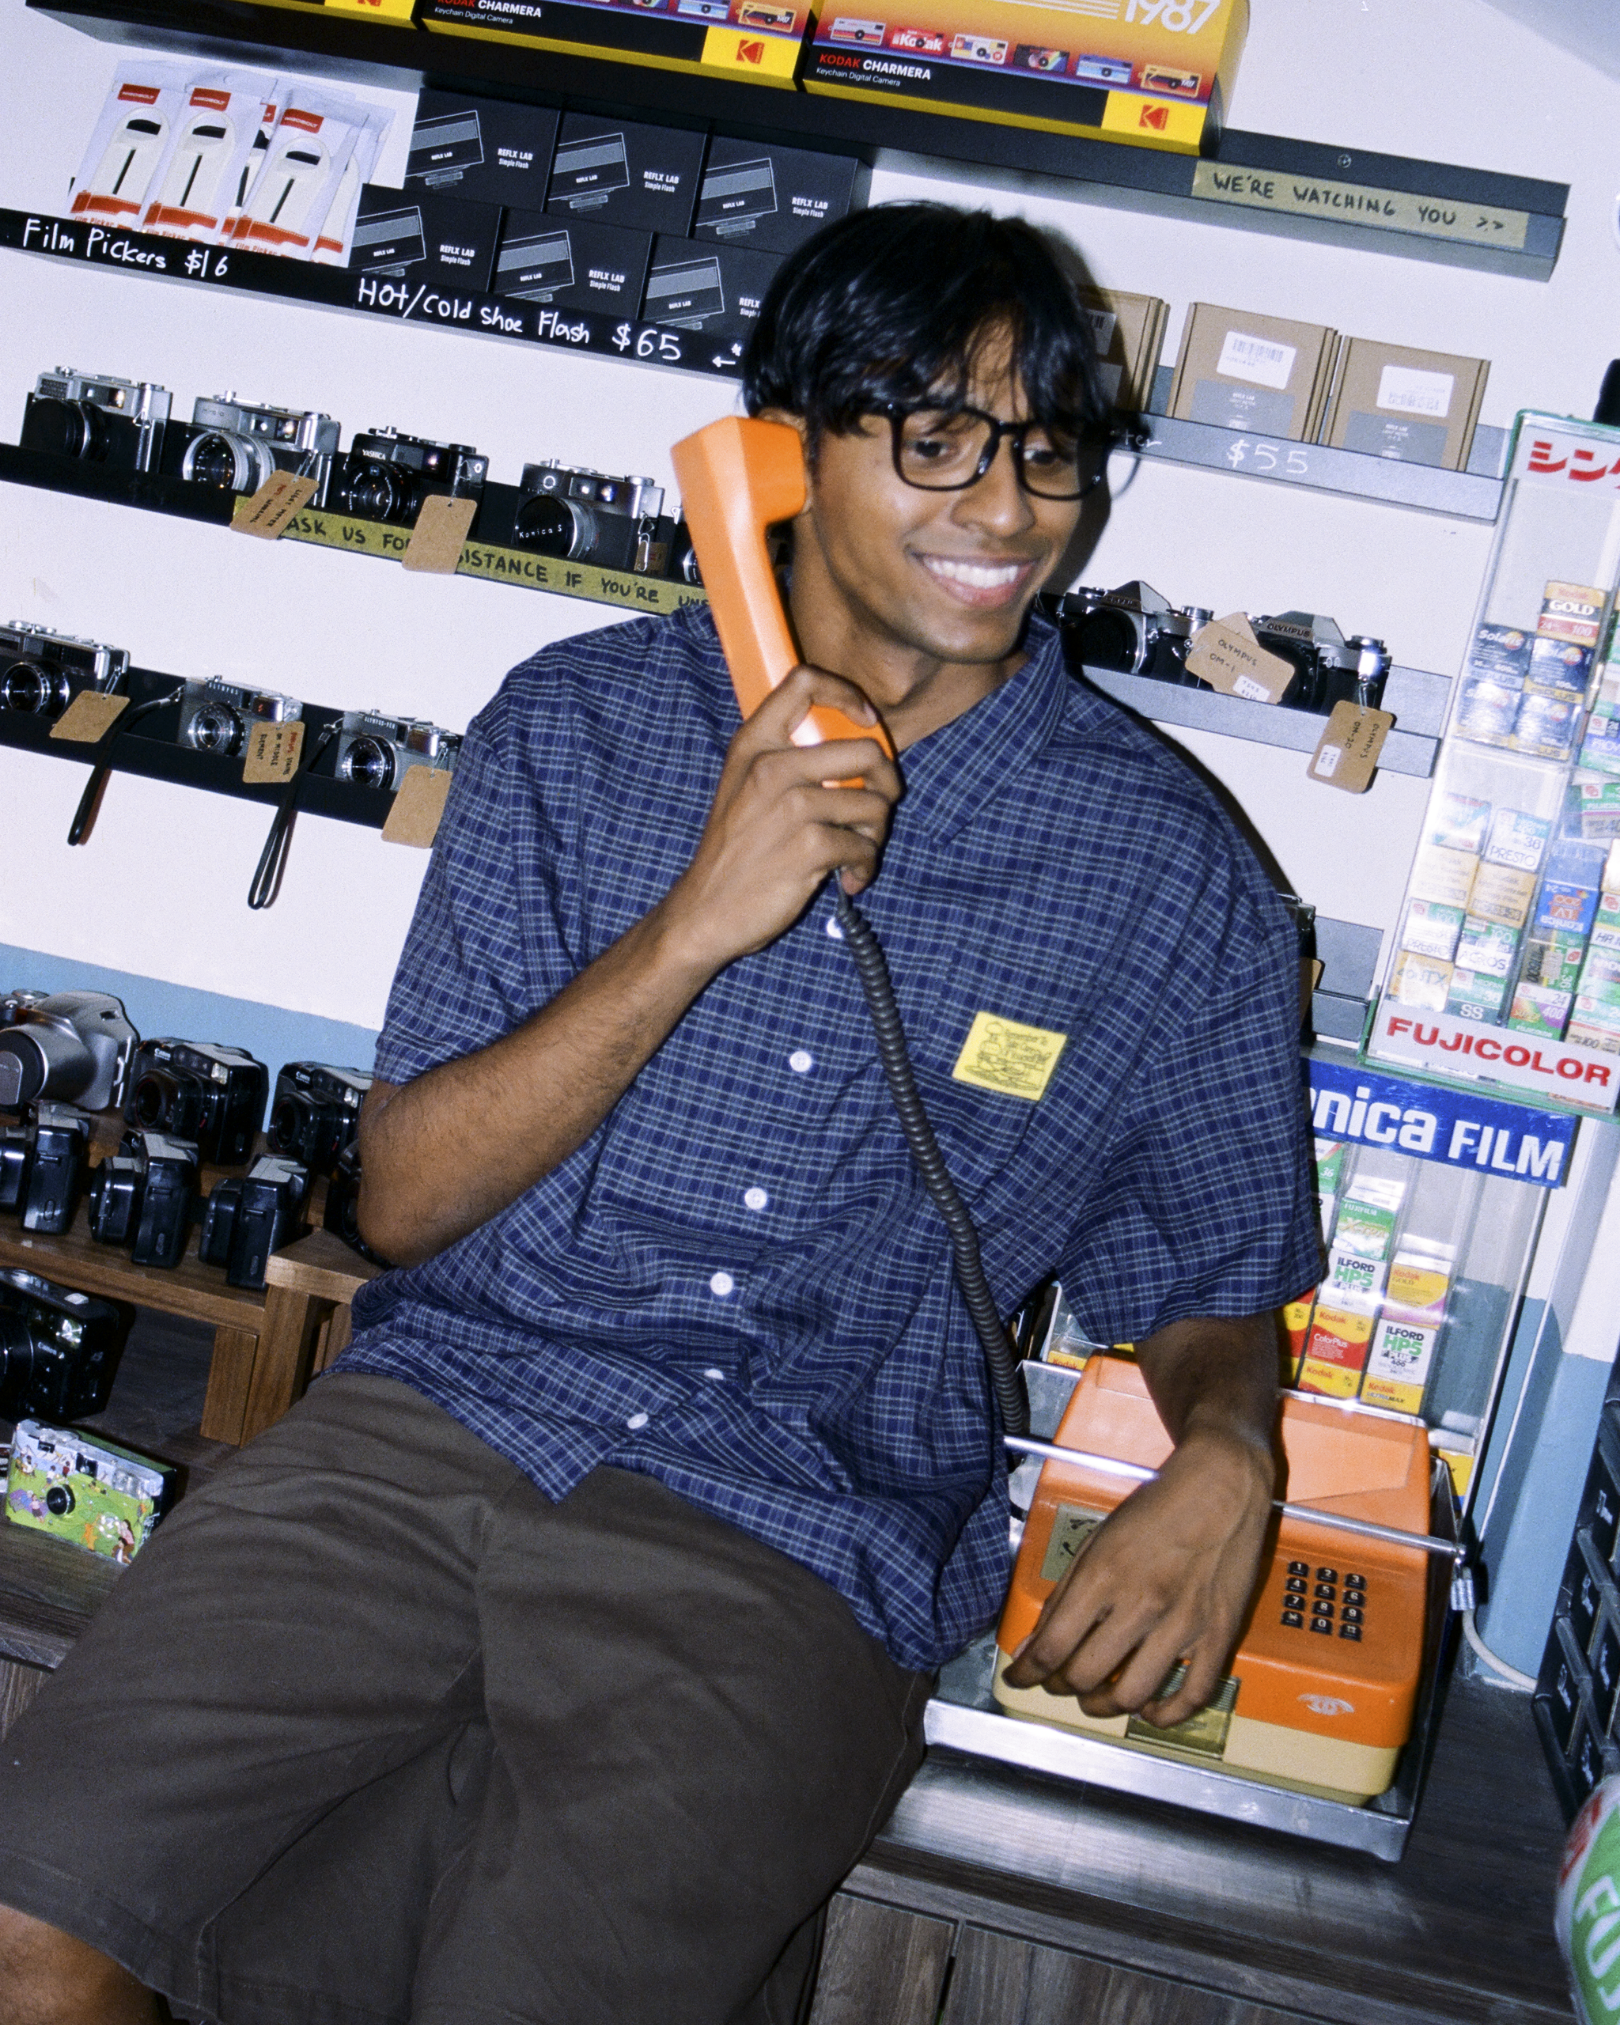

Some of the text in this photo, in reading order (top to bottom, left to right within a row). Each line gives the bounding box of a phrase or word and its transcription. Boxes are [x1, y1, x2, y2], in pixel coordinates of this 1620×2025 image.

[433, 6, 514, 25] Keychain Digital Camera
[477, 0, 542, 18] CHARMERA
[819, 53, 931, 81] KODAK CHARMERA
[816, 66, 901, 88] Keychain Digital Camera
[498, 148, 533, 161] REFLX LAB
[498, 158, 529, 169] Simple Flash
[643, 171, 680, 184] REFLX LAB
[644, 181, 675, 193] Simple Flash
[791, 197, 828, 210] REFLX LAB
[1213, 171, 1275, 199] WE'RE
[1292, 184, 1397, 217] WATCHING
[1418, 205, 1456, 226] YOU
[792, 207, 824, 218] Simple Flash
[23, 218, 229, 278] Film Pickers $16
[440, 244, 475, 258] REFLX LAB
[440, 254, 471, 266] Simple Flash
[588, 269, 625, 283] REFLX LAB
[589, 280, 621, 292] Simple Flash
[739, 297, 760, 308] REFLX
[538, 311, 590, 343] Flash
[612, 323, 682, 360] $65
[362, 449, 386, 461] YASHICA
[1226, 439, 1309, 473] $55
[557, 524, 563, 532] S
[286, 517, 326, 536] ASK
[342, 526, 366, 544] US
[566, 571, 582, 588] IF
[601, 577, 660, 603] YOU'RE
[1549, 599, 1595, 616] GOLD
[1267, 623, 1310, 637] OLYMPUS
[1571, 625, 1593, 637] 100
[1218, 638, 1257, 667] OLYMPUS
[208, 682, 239, 695] OLYMPUS
[1360, 723, 1380, 758] OLYMPUS
[1490, 845, 1537, 867] PRESTO
[1551, 993, 1569, 1006] 24
[1460, 1003, 1484, 1020] SS
[1542, 1006, 1565, 1020] 400
[1386, 1016, 1612, 1087] FUJICOLOR
[1448, 1119, 1565, 1181] FILM
[1320, 1166, 1334, 1177] 36
[1344, 1203, 1377, 1216] FUJIFILM
[1338, 1257, 1375, 1273] ILFORD
[1334, 1265, 1374, 1288] HP5
[1393, 1270, 1420, 1281] Kodak
[1319, 1311, 1347, 1324] Kodak
[1314, 1333, 1348, 1348] ColorPlus
[1386, 1325, 1425, 1342] ILFORD
[1382, 1334, 1423, 1356] HP5
[1306, 1366, 1333, 1380] Kodak
[1368, 1382, 1396, 1395] Kodak
[1297, 1563, 1360, 1583] 1 2 3
[1293, 1579, 1359, 1600] 4 5 6
[1292, 1596, 1357, 1617] 7 8 9
[1318, 1618, 1327, 1628] 0
